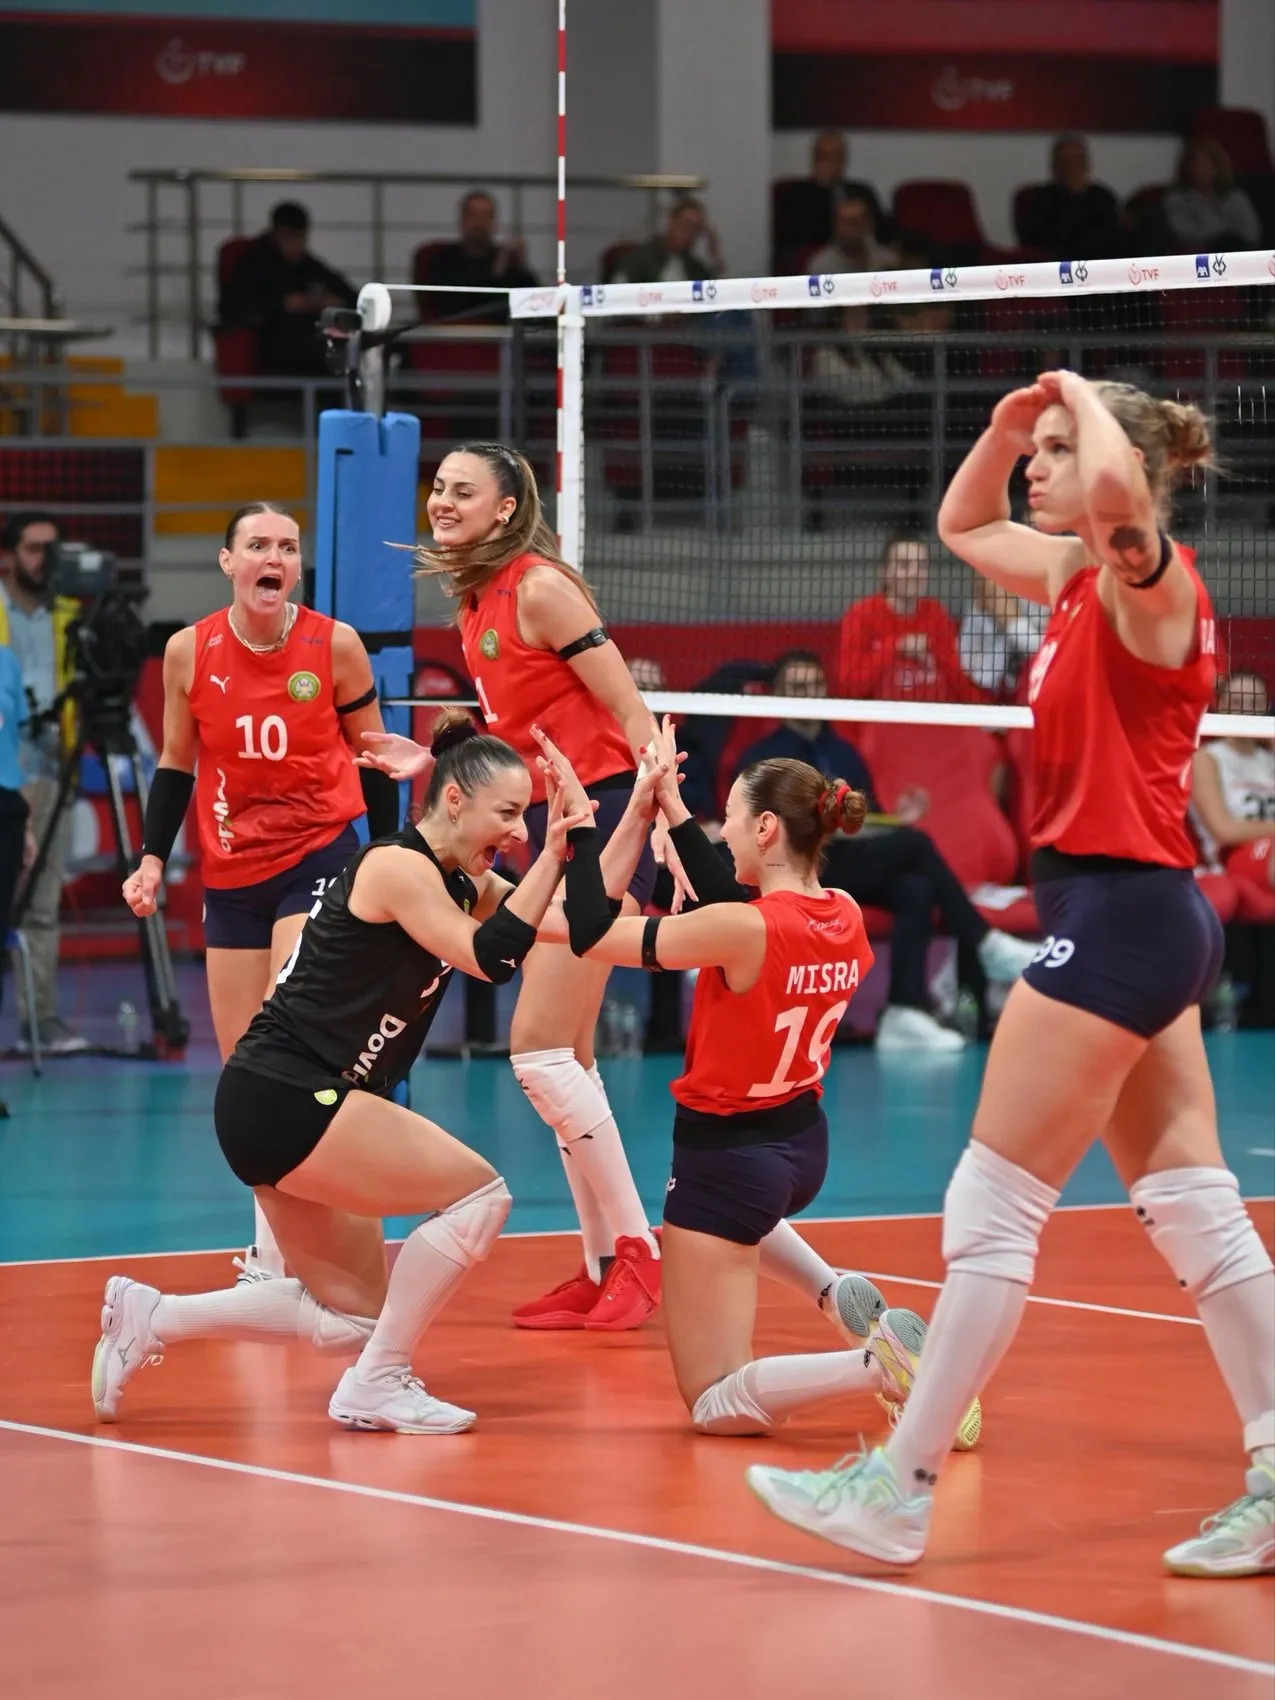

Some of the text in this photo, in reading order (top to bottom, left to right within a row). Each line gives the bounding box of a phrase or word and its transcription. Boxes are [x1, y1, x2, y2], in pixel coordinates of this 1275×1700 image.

[1008, 275, 1025, 287] TVF
[1141, 269, 1160, 281] TVF
[882, 281, 898, 293] TVF
[761, 288, 778, 300] TVF
[235, 714, 289, 762] 10
[785, 959, 859, 995] MISRA
[746, 1000, 848, 1098] 19
